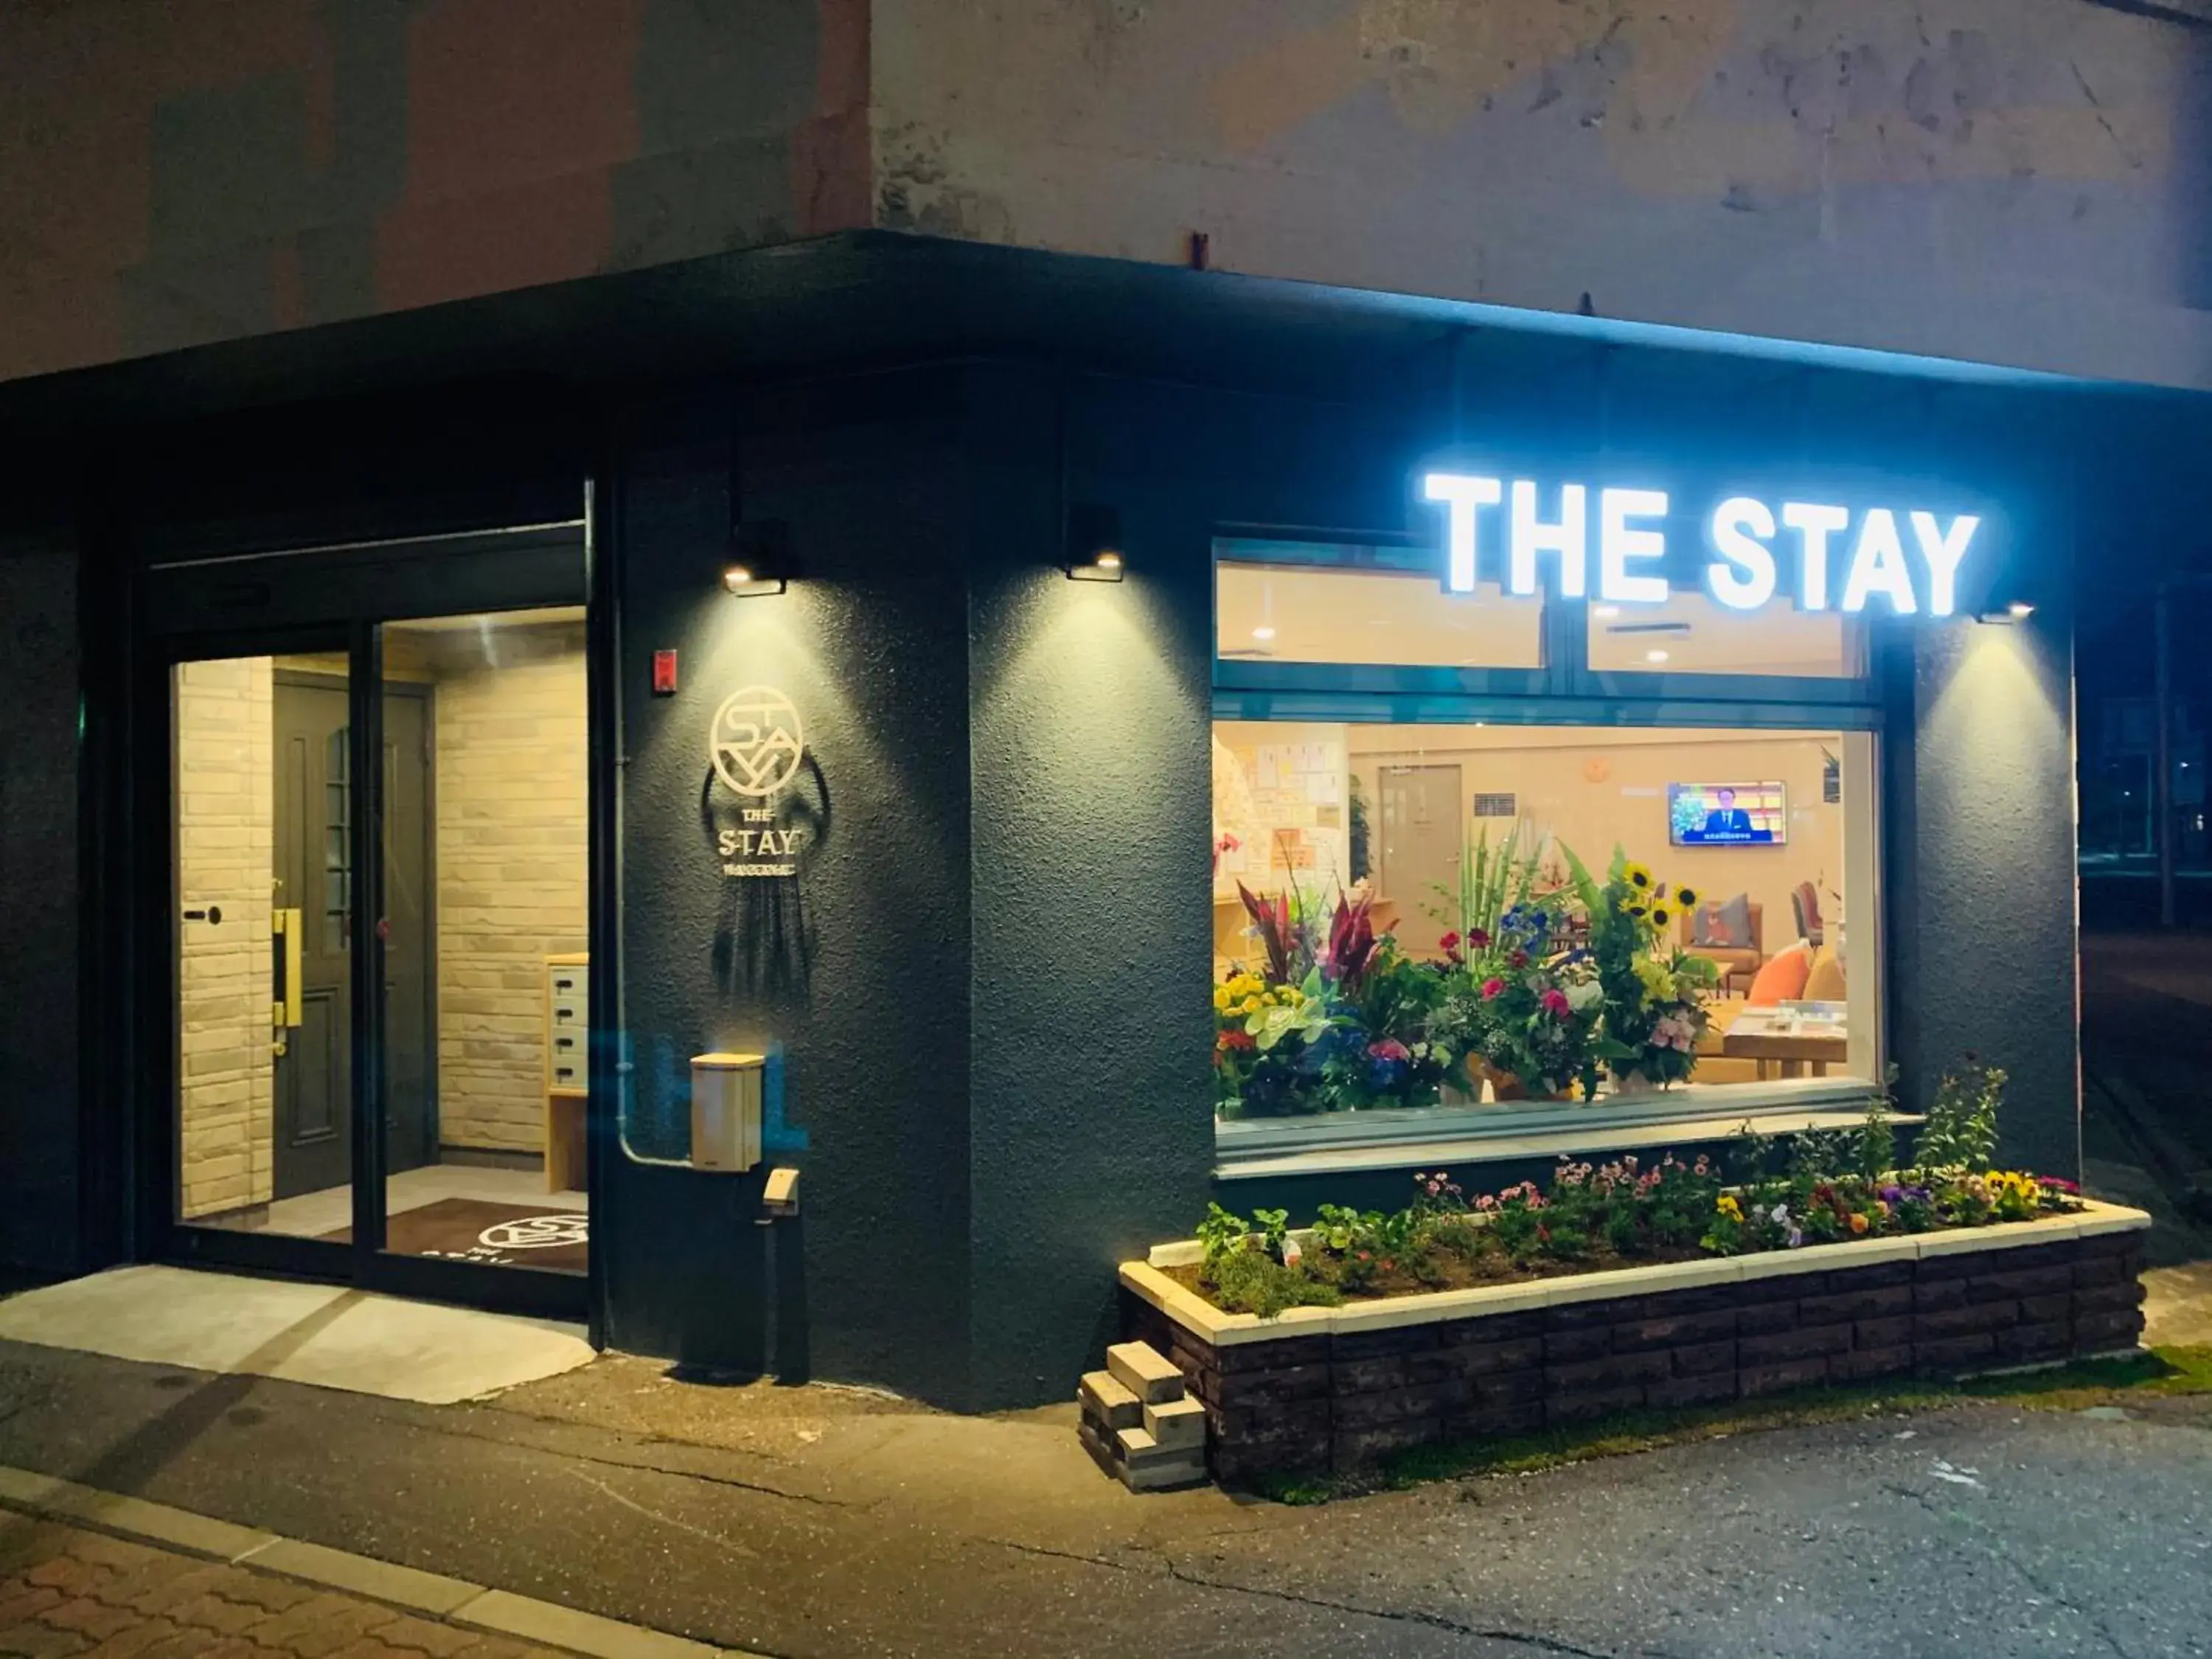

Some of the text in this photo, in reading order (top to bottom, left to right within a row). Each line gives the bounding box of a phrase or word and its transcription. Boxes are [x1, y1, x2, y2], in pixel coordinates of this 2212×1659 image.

[1425, 473, 1981, 617] THE STAY
[741, 809, 776, 822] THE
[719, 830, 801, 856] STAY
